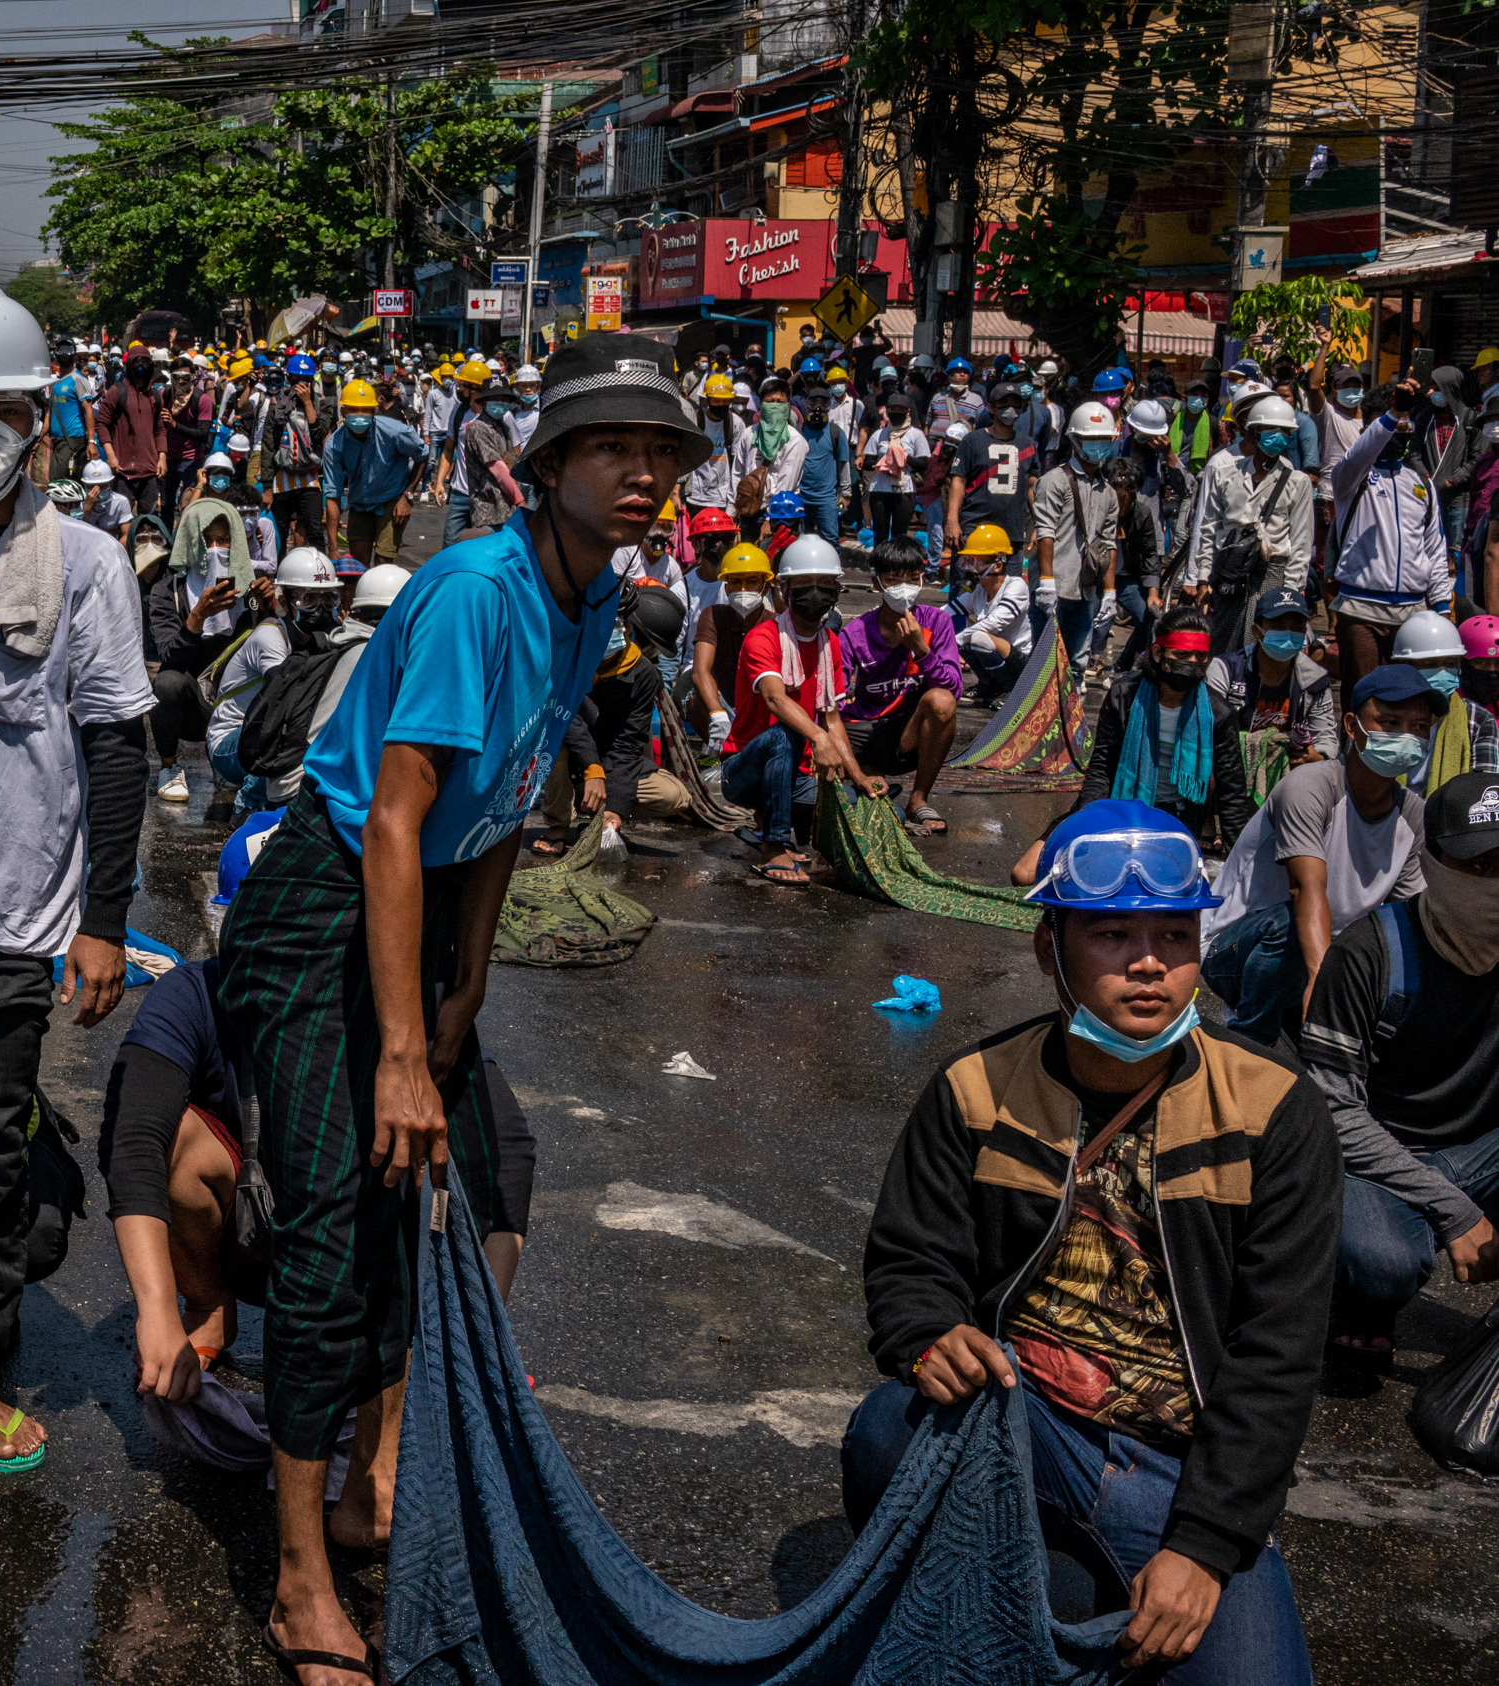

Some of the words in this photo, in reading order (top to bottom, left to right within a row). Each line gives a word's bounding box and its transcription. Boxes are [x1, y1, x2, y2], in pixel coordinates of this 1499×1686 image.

[725, 228, 800, 263] Fashion
[739, 254, 800, 286] Cherish
[377, 296, 403, 307] CDM
[484, 299, 496, 307] TT
[988, 443, 1019, 495] 3
[1468, 812, 1492, 824] BEN
